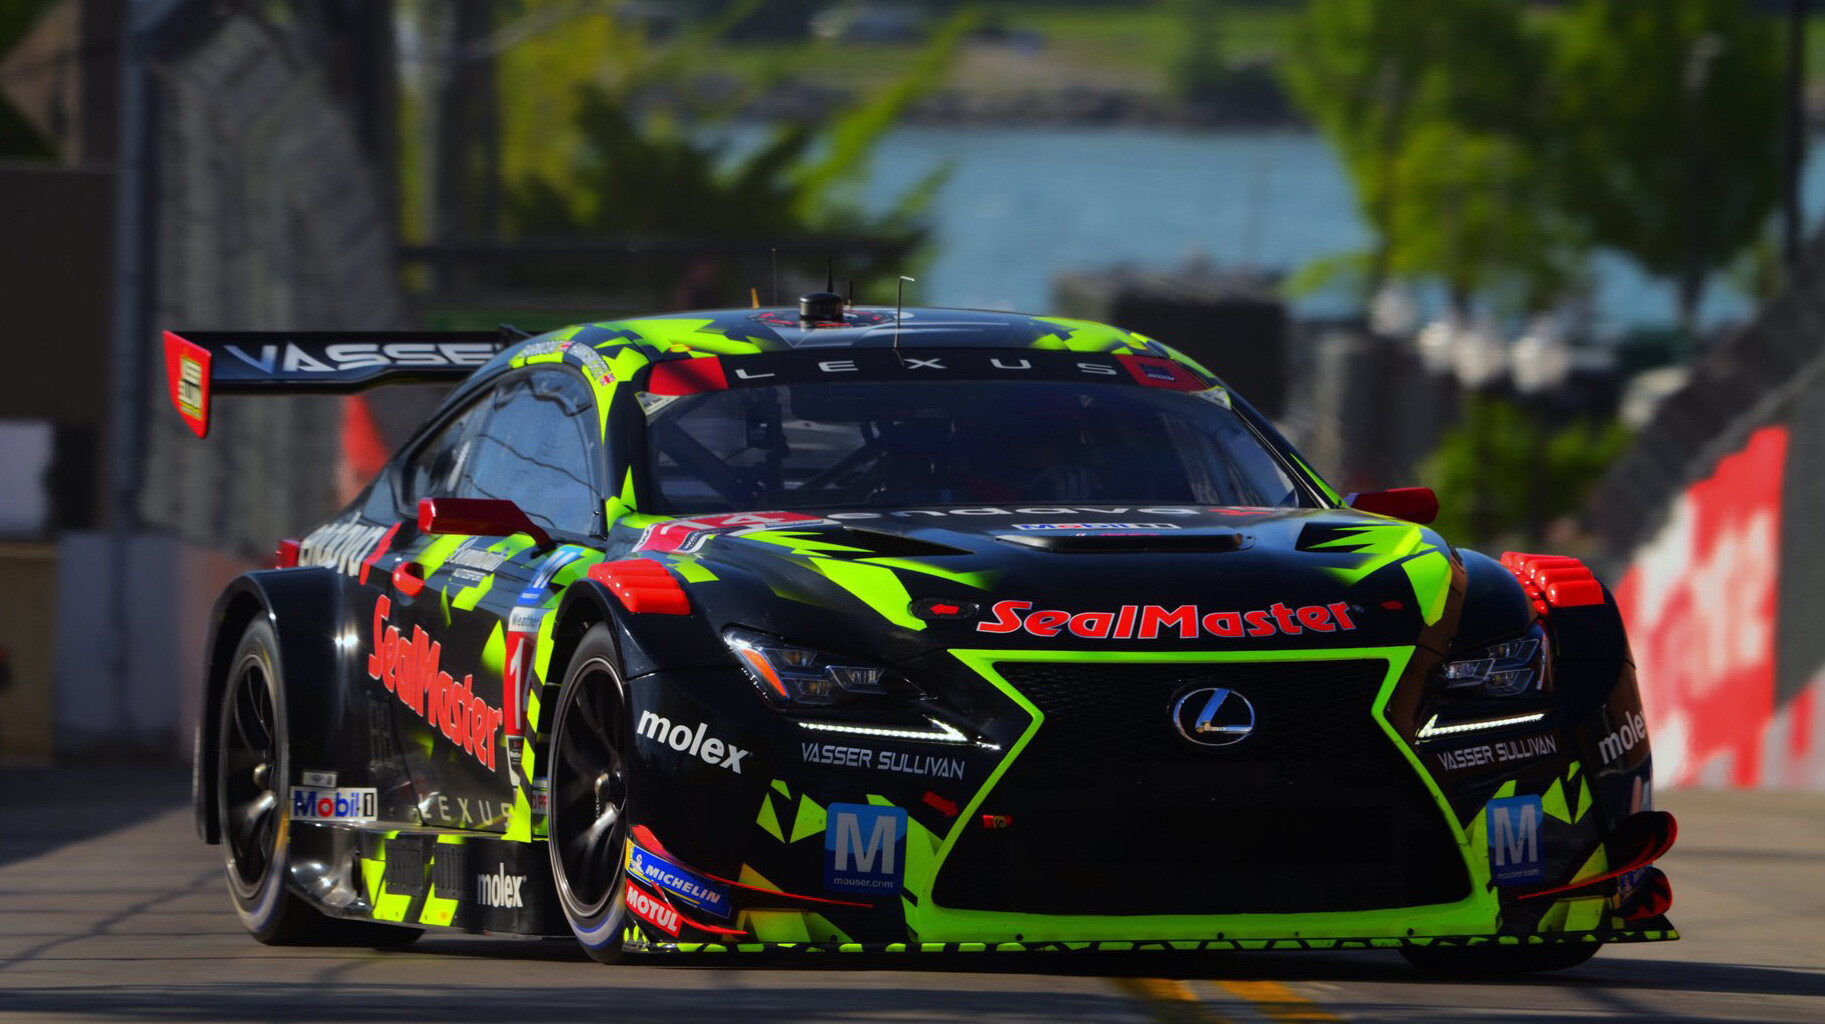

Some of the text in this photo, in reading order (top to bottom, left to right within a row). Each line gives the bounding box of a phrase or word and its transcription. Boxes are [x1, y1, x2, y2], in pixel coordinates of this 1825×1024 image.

[223, 341, 502, 374] VASSE
[735, 357, 1118, 380] LEXUS
[827, 506, 1201, 520] endava
[976, 600, 1358, 639] SealMaster
[368, 594, 499, 773] SealMaster
[636, 709, 750, 774] molex
[1438, 735, 1557, 772] VASSER SULLIVAN
[1598, 710, 1648, 765] mole
[801, 742, 965, 780] VASSER SULLIVAN
[293, 790, 360, 817] Mobil
[834, 812, 898, 874] M
[1493, 804, 1539, 867] M
[477, 862, 524, 909] molex
[645, 864, 722, 904] MICHELIN
[627, 886, 678, 932] MOTUL
